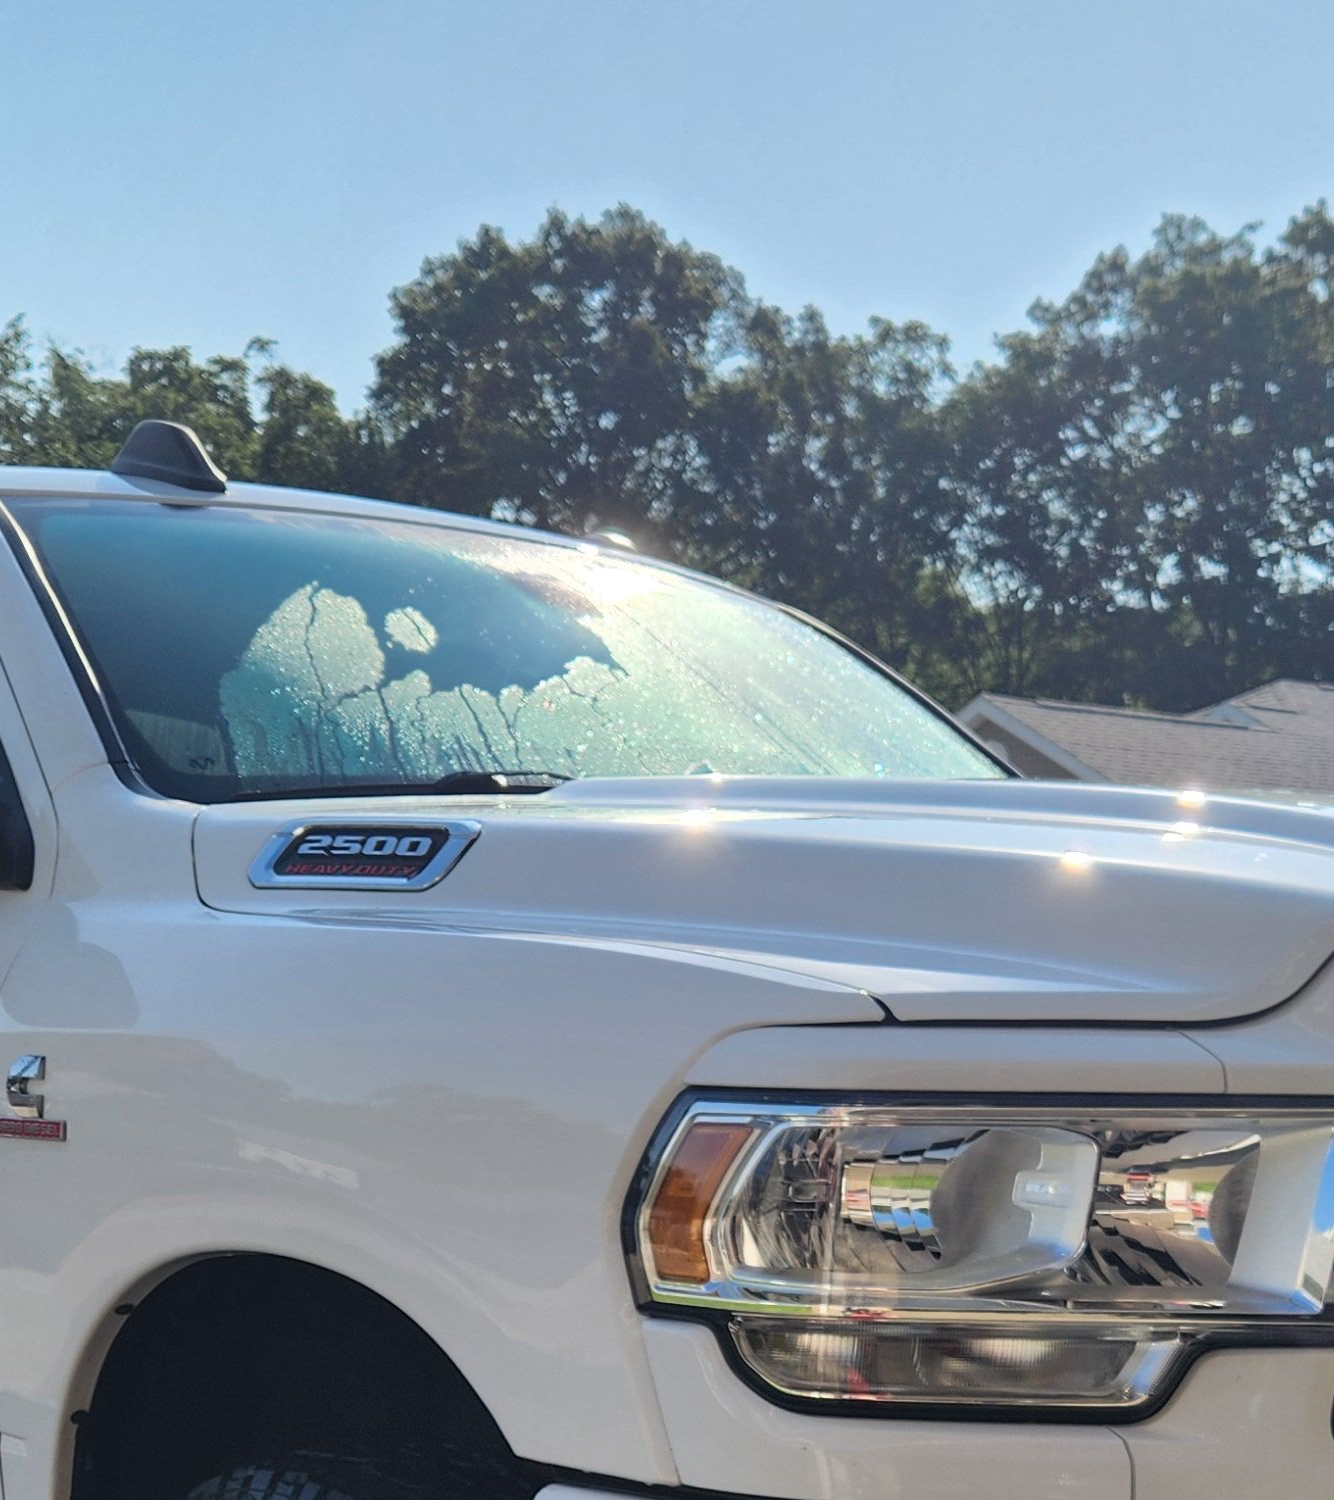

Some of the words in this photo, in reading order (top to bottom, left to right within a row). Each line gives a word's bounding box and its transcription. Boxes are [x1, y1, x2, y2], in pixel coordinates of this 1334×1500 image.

[297, 834, 433, 857] 2500
[285, 864, 353, 875] HEAVY
[355, 865, 418, 876] DUTY
